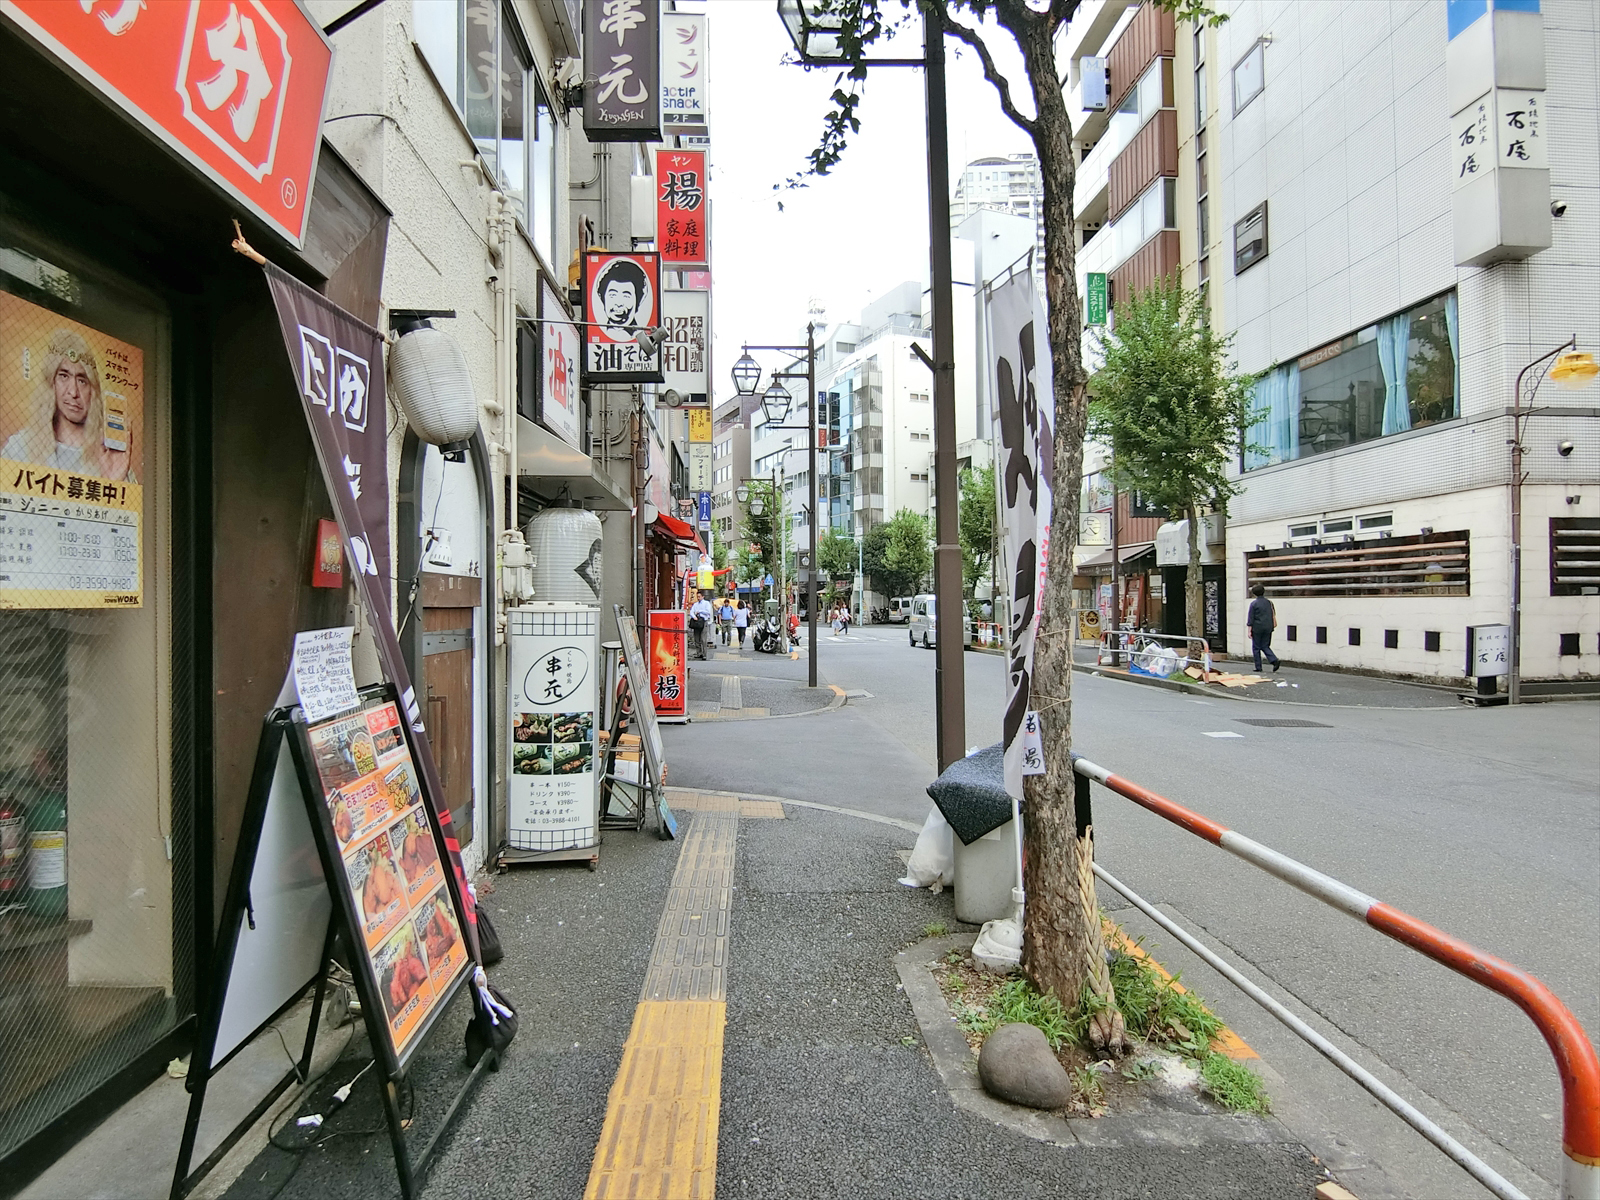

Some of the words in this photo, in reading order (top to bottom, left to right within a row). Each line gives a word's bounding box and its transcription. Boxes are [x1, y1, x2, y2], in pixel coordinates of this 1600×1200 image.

[675, 24, 699, 79] ジュン
[663, 97, 700, 109] snack
[670, 155, 692, 167] ヤン
[659, 170, 703, 211] 楊
[665, 218, 700, 238] 家庭
[663, 238, 699, 258] 料理
[105, 373, 139, 391] タウンワーク
[544, 655, 563, 699] 串元
[654, 674, 681, 701] 楊
